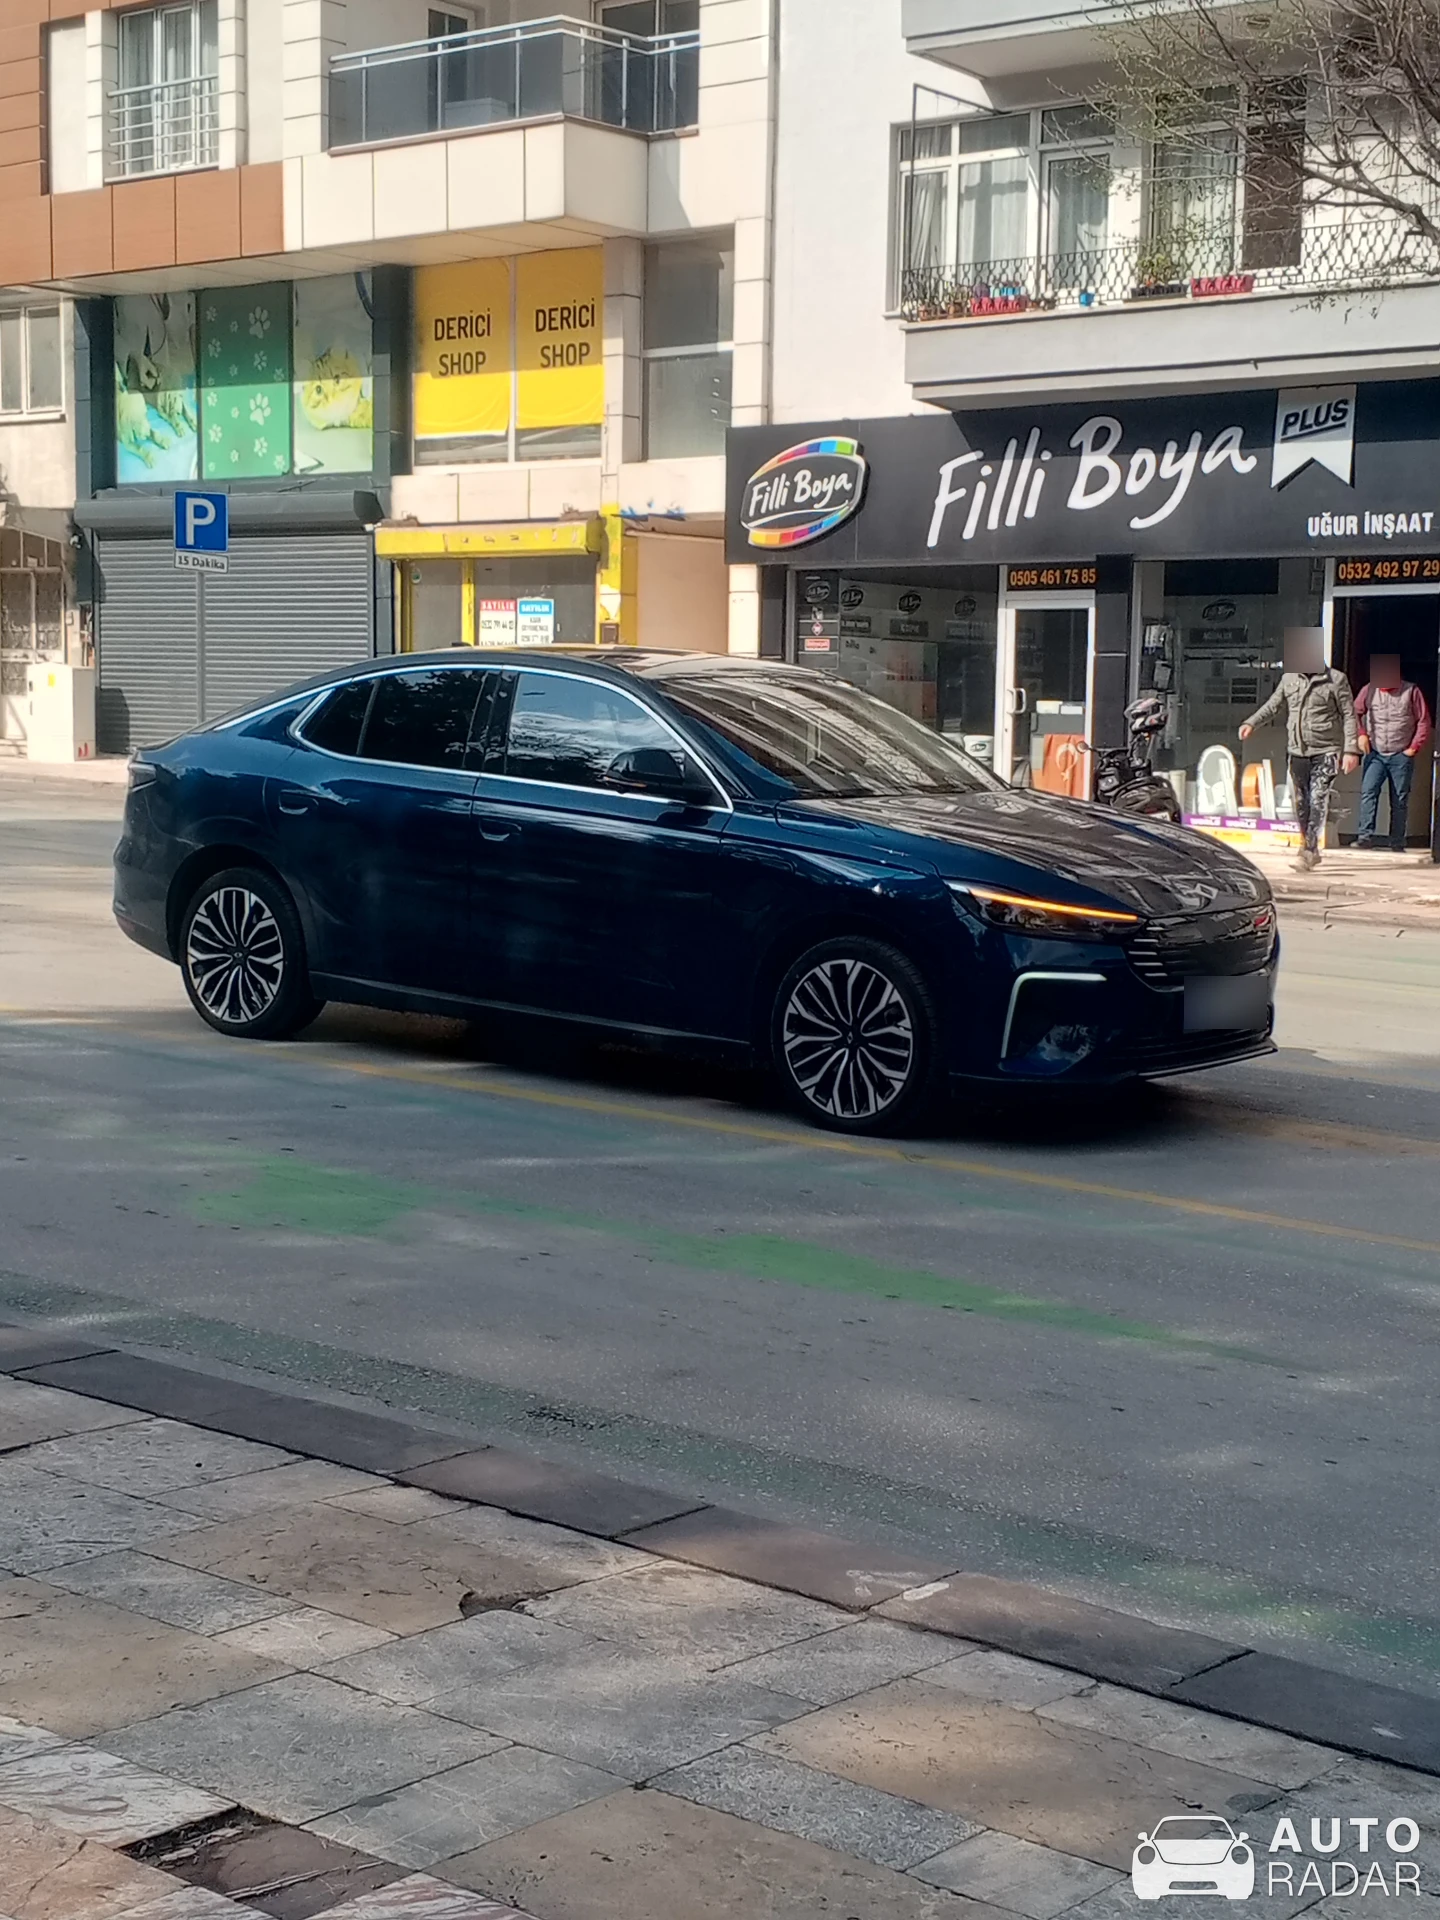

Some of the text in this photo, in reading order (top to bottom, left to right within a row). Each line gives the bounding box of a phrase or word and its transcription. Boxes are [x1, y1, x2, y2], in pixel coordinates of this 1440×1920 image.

[434, 308, 491, 341] DERİCİ
[535, 298, 596, 332] DERİCİ
[438, 351, 487, 376] SHOP
[540, 342, 591, 368] SHOP
[1281, 399, 1349, 437] PLUS
[748, 469, 853, 518] Filli Boya
[926, 415, 1258, 548] Filli Boya
[185, 497, 217, 546] P
[1307, 511, 1435, 539] UĞUR İNŞAAT
[178, 555, 225, 570] 15 Dakika
[1009, 567, 1096, 586] 0505 461 75 85
[1338, 560, 1440, 579] 0532 492 97 29
